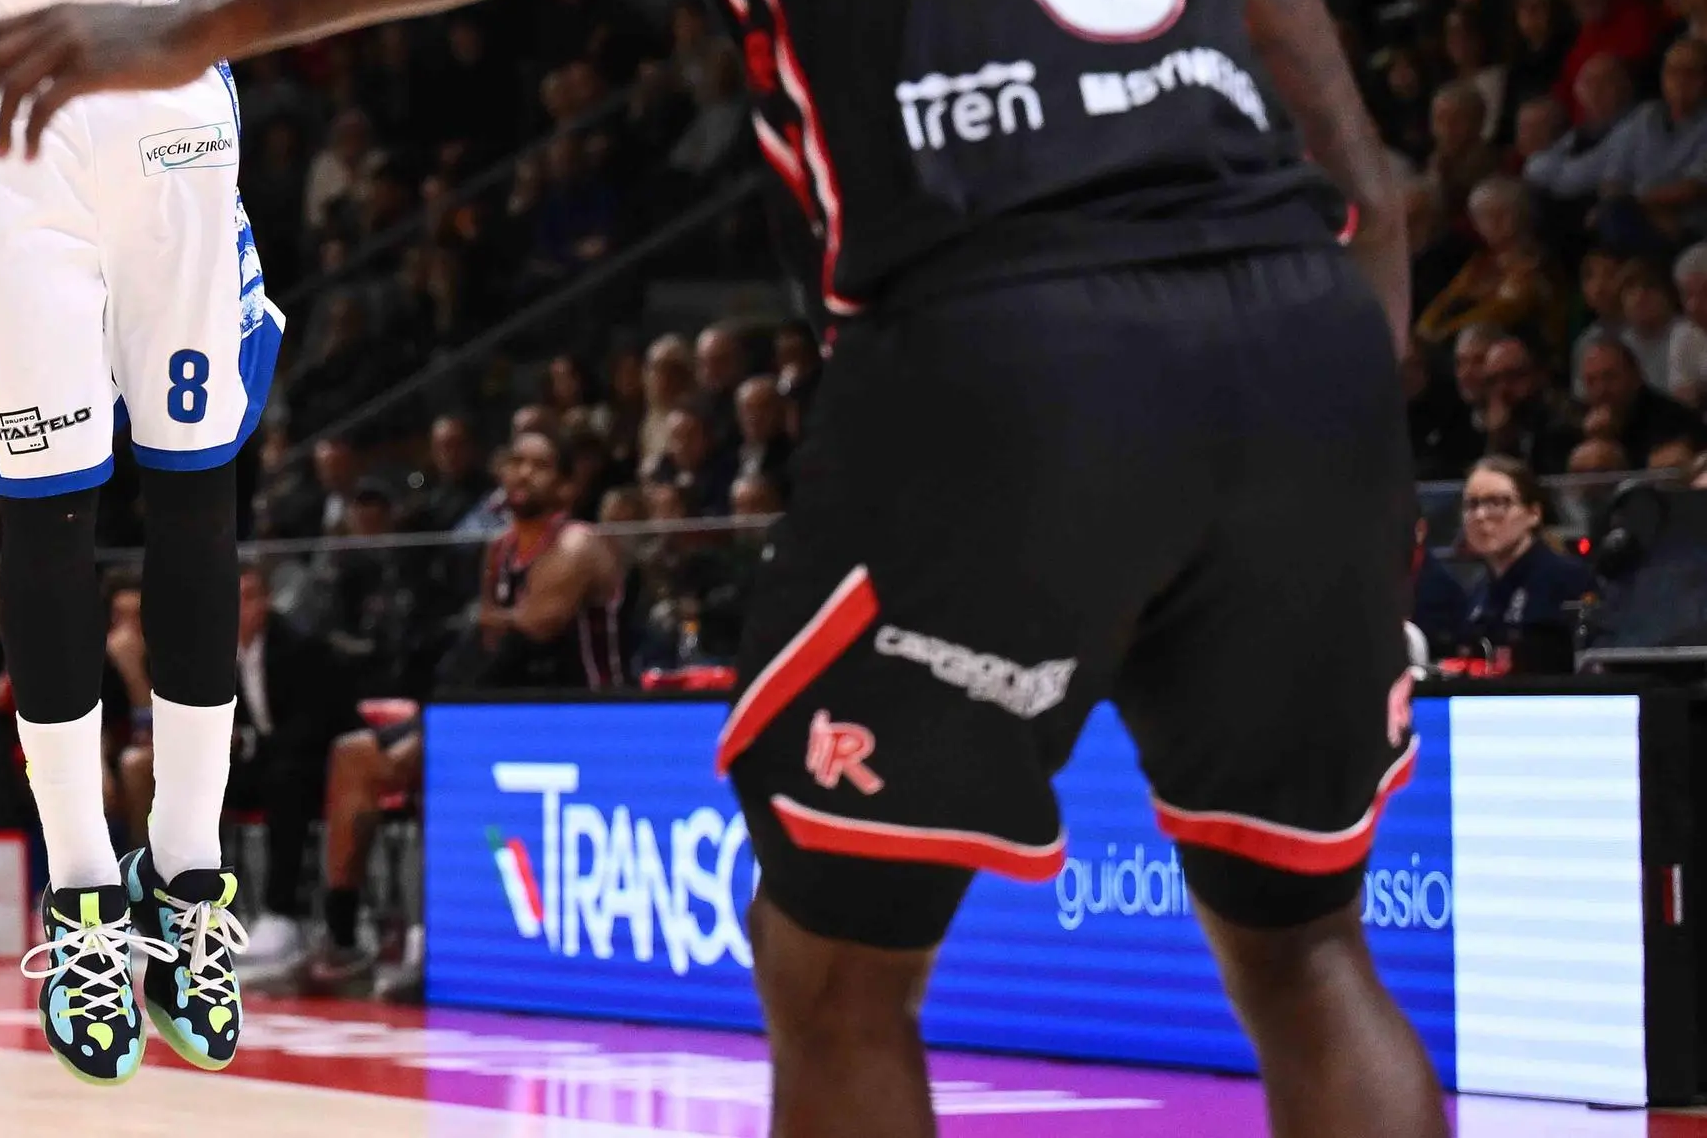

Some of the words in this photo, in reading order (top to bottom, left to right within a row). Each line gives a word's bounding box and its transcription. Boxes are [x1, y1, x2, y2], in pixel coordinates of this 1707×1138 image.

[897, 74, 1044, 151] iren
[146, 143, 191, 162] VECCHI
[167, 348, 210, 424] 8
